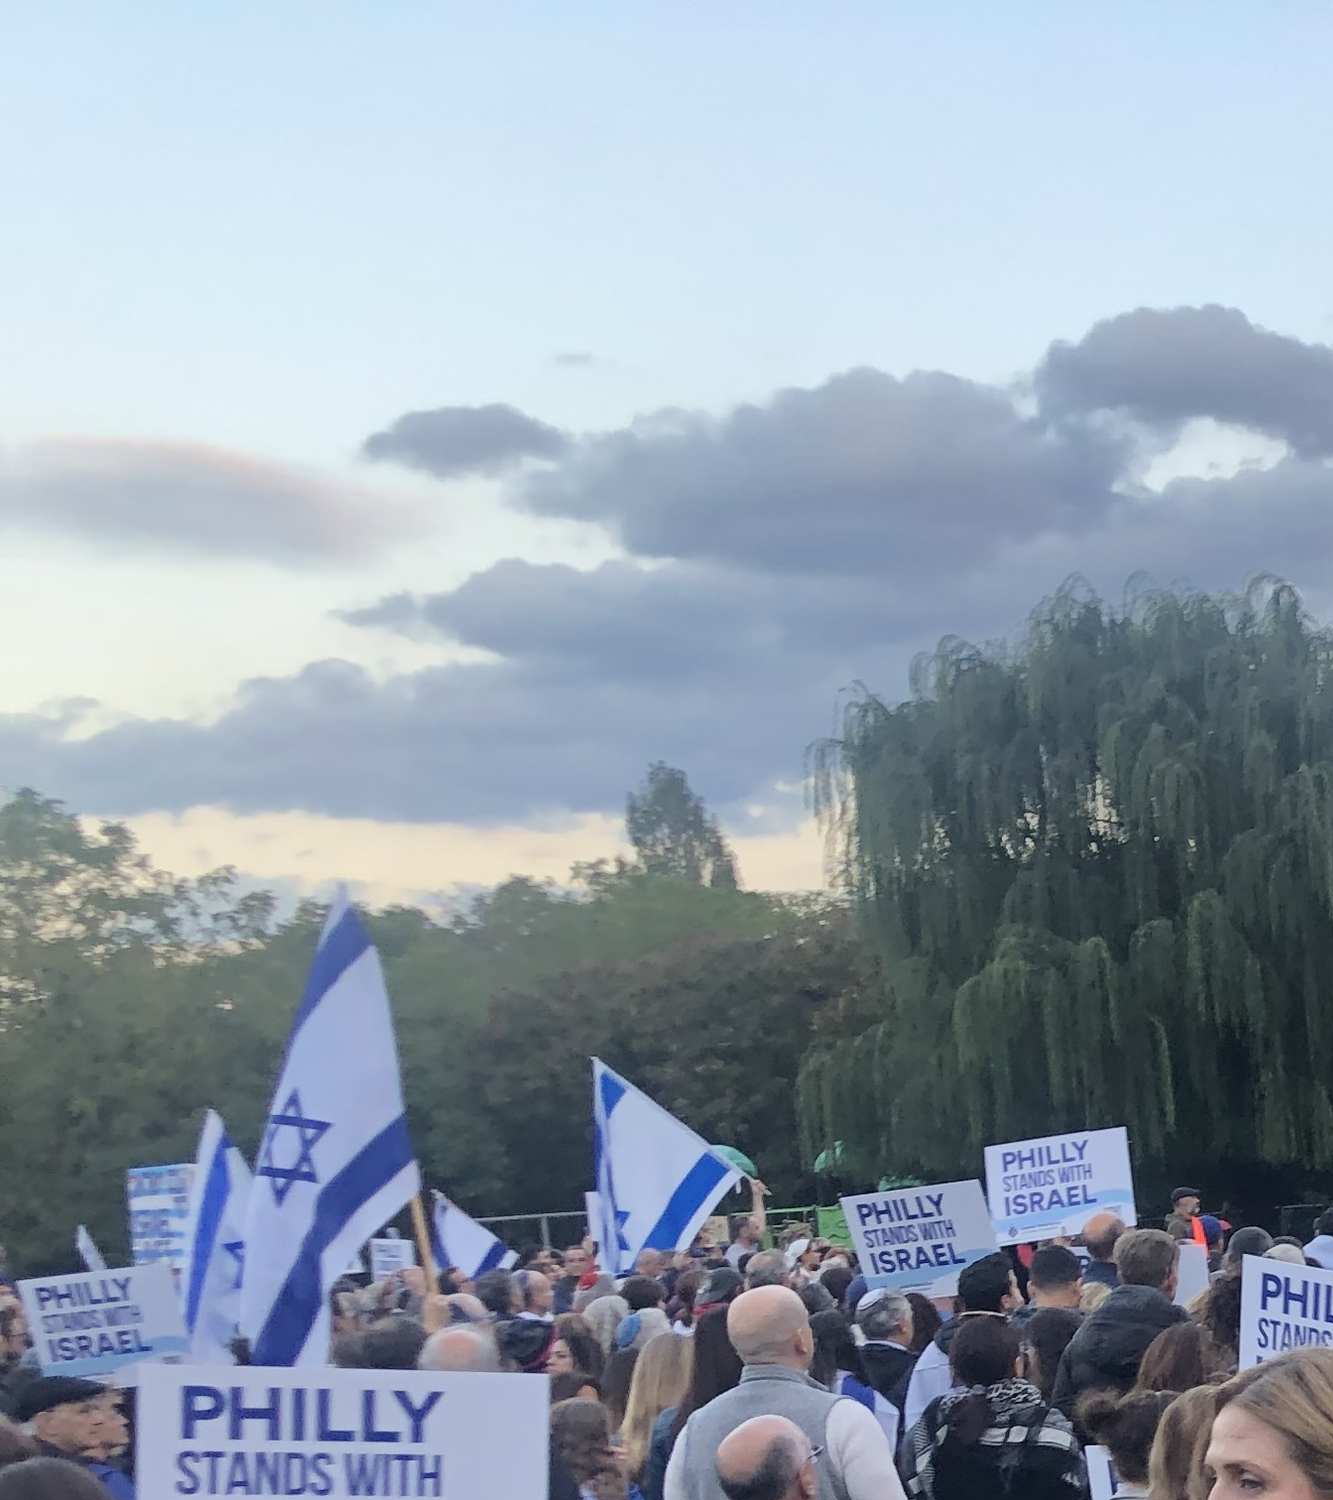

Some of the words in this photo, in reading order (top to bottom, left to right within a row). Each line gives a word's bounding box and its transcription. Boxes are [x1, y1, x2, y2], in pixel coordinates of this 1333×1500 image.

[1001, 1139, 1089, 1173] PHILLY
[1002, 1168, 1055, 1193] STANDS
[1057, 1163, 1093, 1184] WITH
[856, 1193, 944, 1226] PHILLY
[1004, 1184, 1097, 1217] ISRAEL
[862, 1222, 920, 1248] STANDS
[921, 1218, 956, 1241] WITH
[869, 1242, 966, 1275] ISRAEL
[35, 1276, 133, 1311] PHILLY
[48, 1329, 153, 1363] ISRAEL
[180, 1385, 445, 1443] PHILLY
[175, 1450, 335, 1496] STANDS
[343, 1452, 443, 1497] WITH
